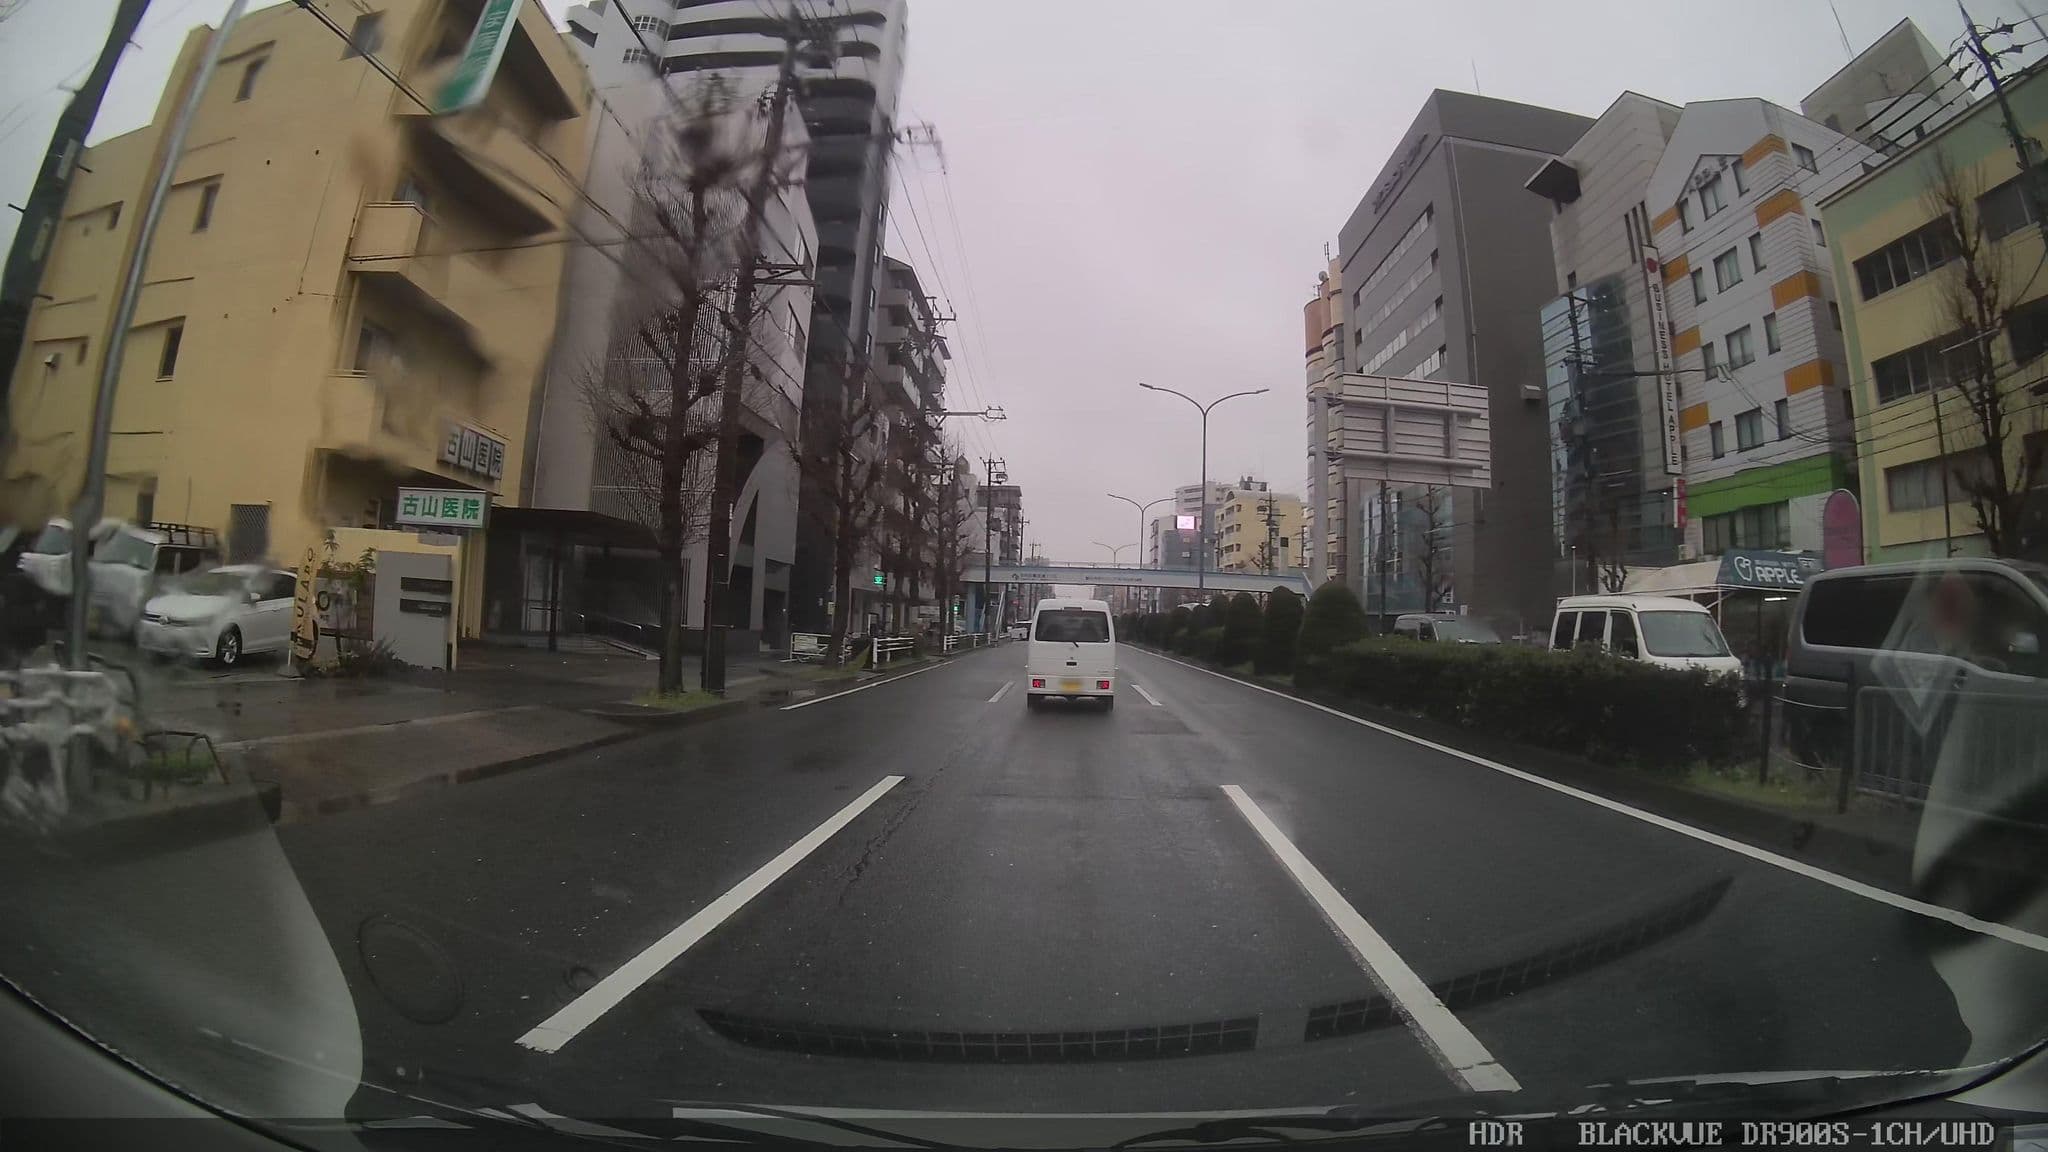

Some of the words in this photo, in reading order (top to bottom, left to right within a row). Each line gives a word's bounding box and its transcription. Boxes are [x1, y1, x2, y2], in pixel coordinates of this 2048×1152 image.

[1652, 283, 1669, 359] BUSINESS
[1663, 362, 1674, 411] HOTEL
[448, 432, 502, 473] 古山医院
[1668, 415, 1679, 465] APPLE
[402, 494, 481, 520] 古山医院
[1755, 567, 1805, 584] APPLE
